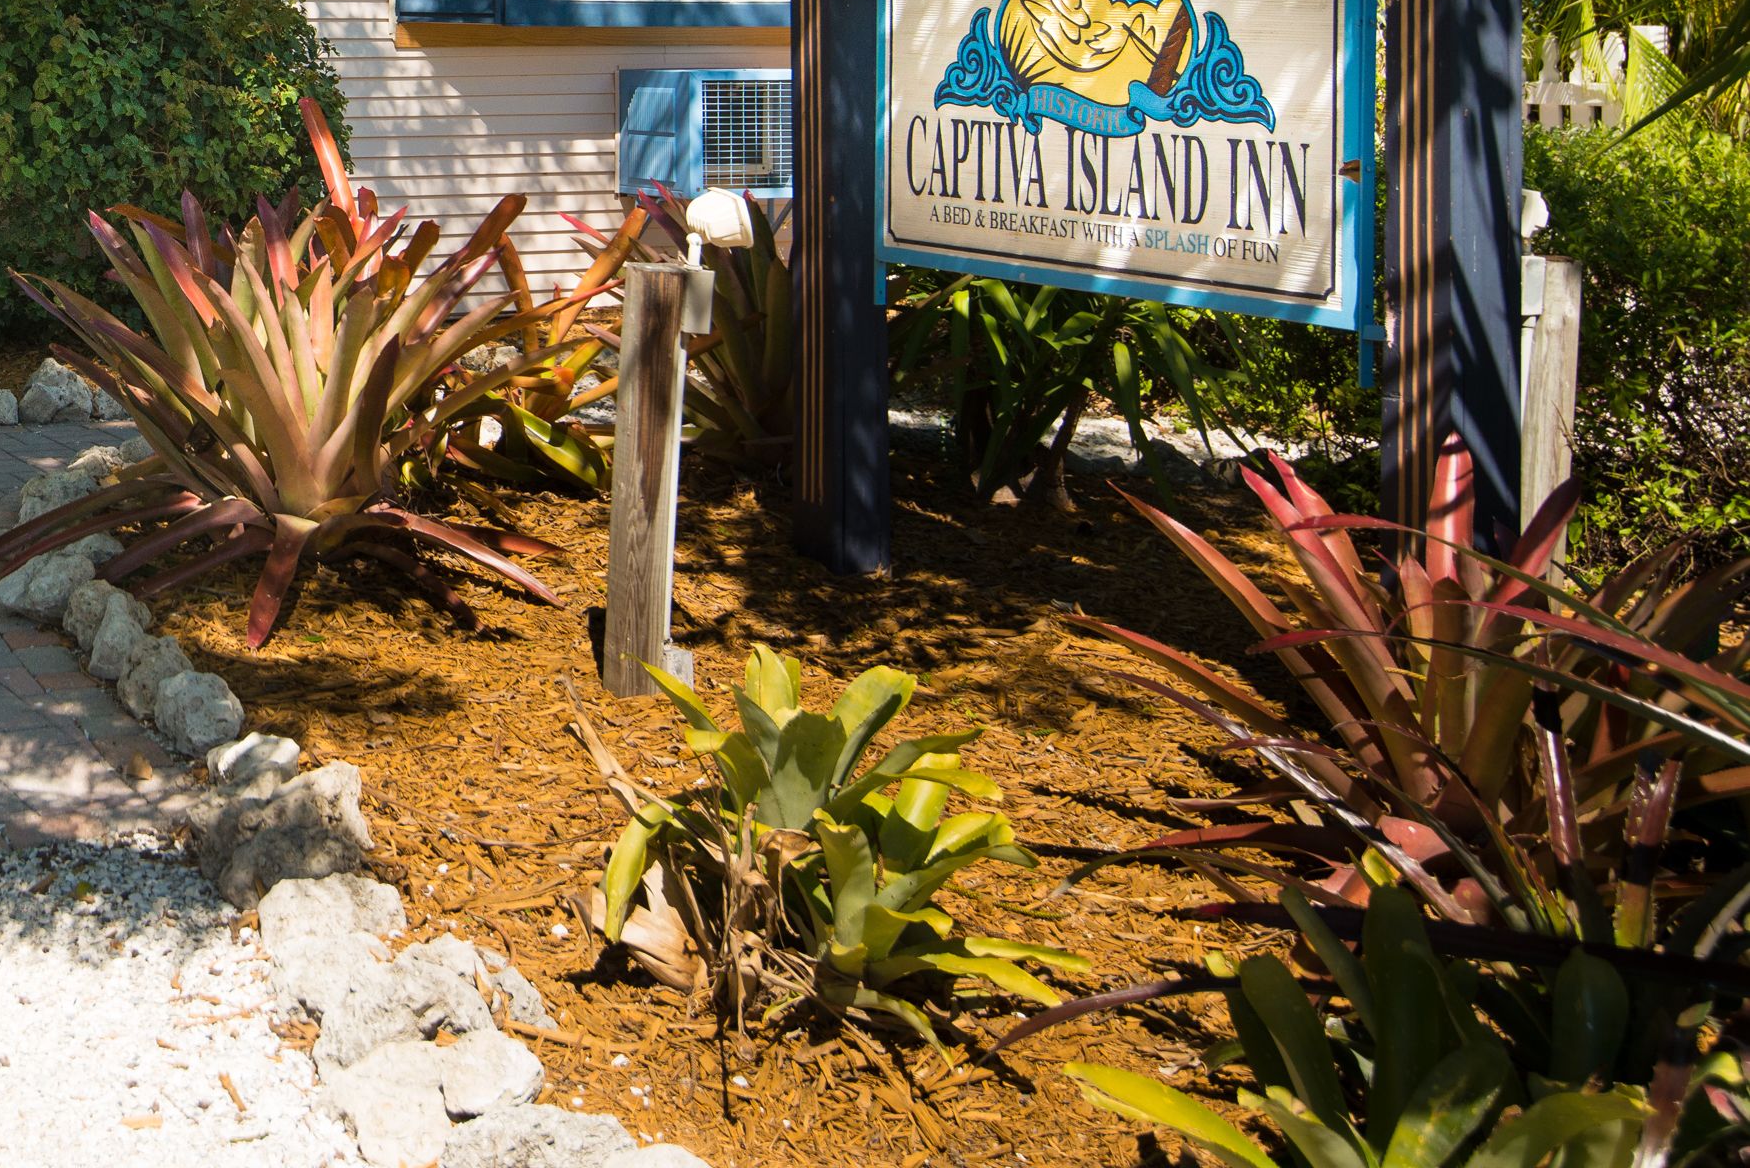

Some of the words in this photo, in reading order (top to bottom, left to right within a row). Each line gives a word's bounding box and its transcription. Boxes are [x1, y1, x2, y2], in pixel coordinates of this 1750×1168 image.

[1034, 89, 1129, 133] HISTORIC
[907, 115, 1048, 208] CAPTIVA
[1064, 125, 1209, 226] ISLAND
[1227, 138, 1311, 239] INN
[930, 204, 940, 223] A
[943, 205, 971, 226] BED
[974, 209, 986, 228] &
[989, 210, 1079, 240] BREAKFAST
[1082, 221, 1124, 248] WITH
[1129, 226, 1141, 248] A
[1144, 228, 1210, 256] SPLASH
[1213, 236, 1238, 260] OF
[1241, 238, 1280, 264] FUN
